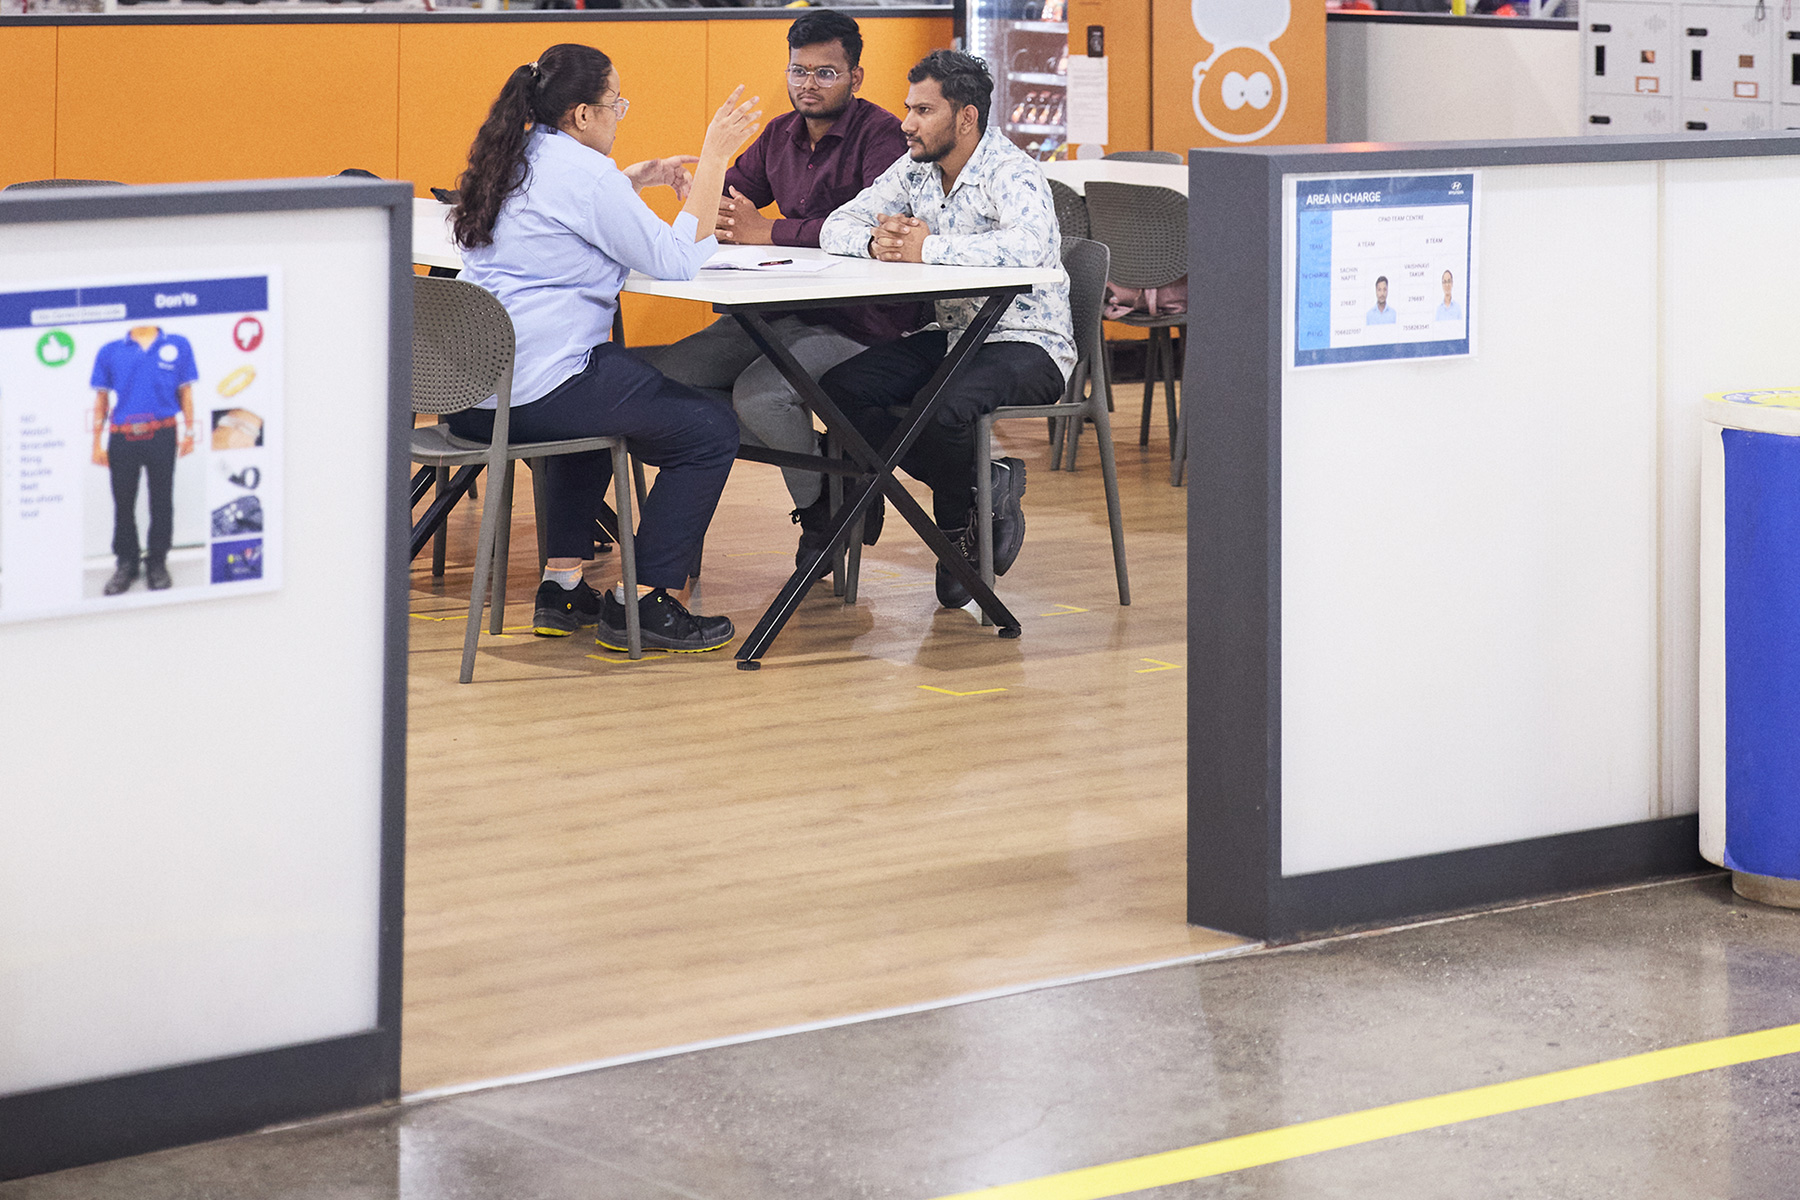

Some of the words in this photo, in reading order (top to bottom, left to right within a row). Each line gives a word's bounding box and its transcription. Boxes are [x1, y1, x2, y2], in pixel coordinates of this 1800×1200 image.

[1306, 194, 1331, 205] AREA
[1332, 193, 1342, 204] IN
[1343, 191, 1381, 203] CHARGE
[154, 292, 198, 309] Don'ts
